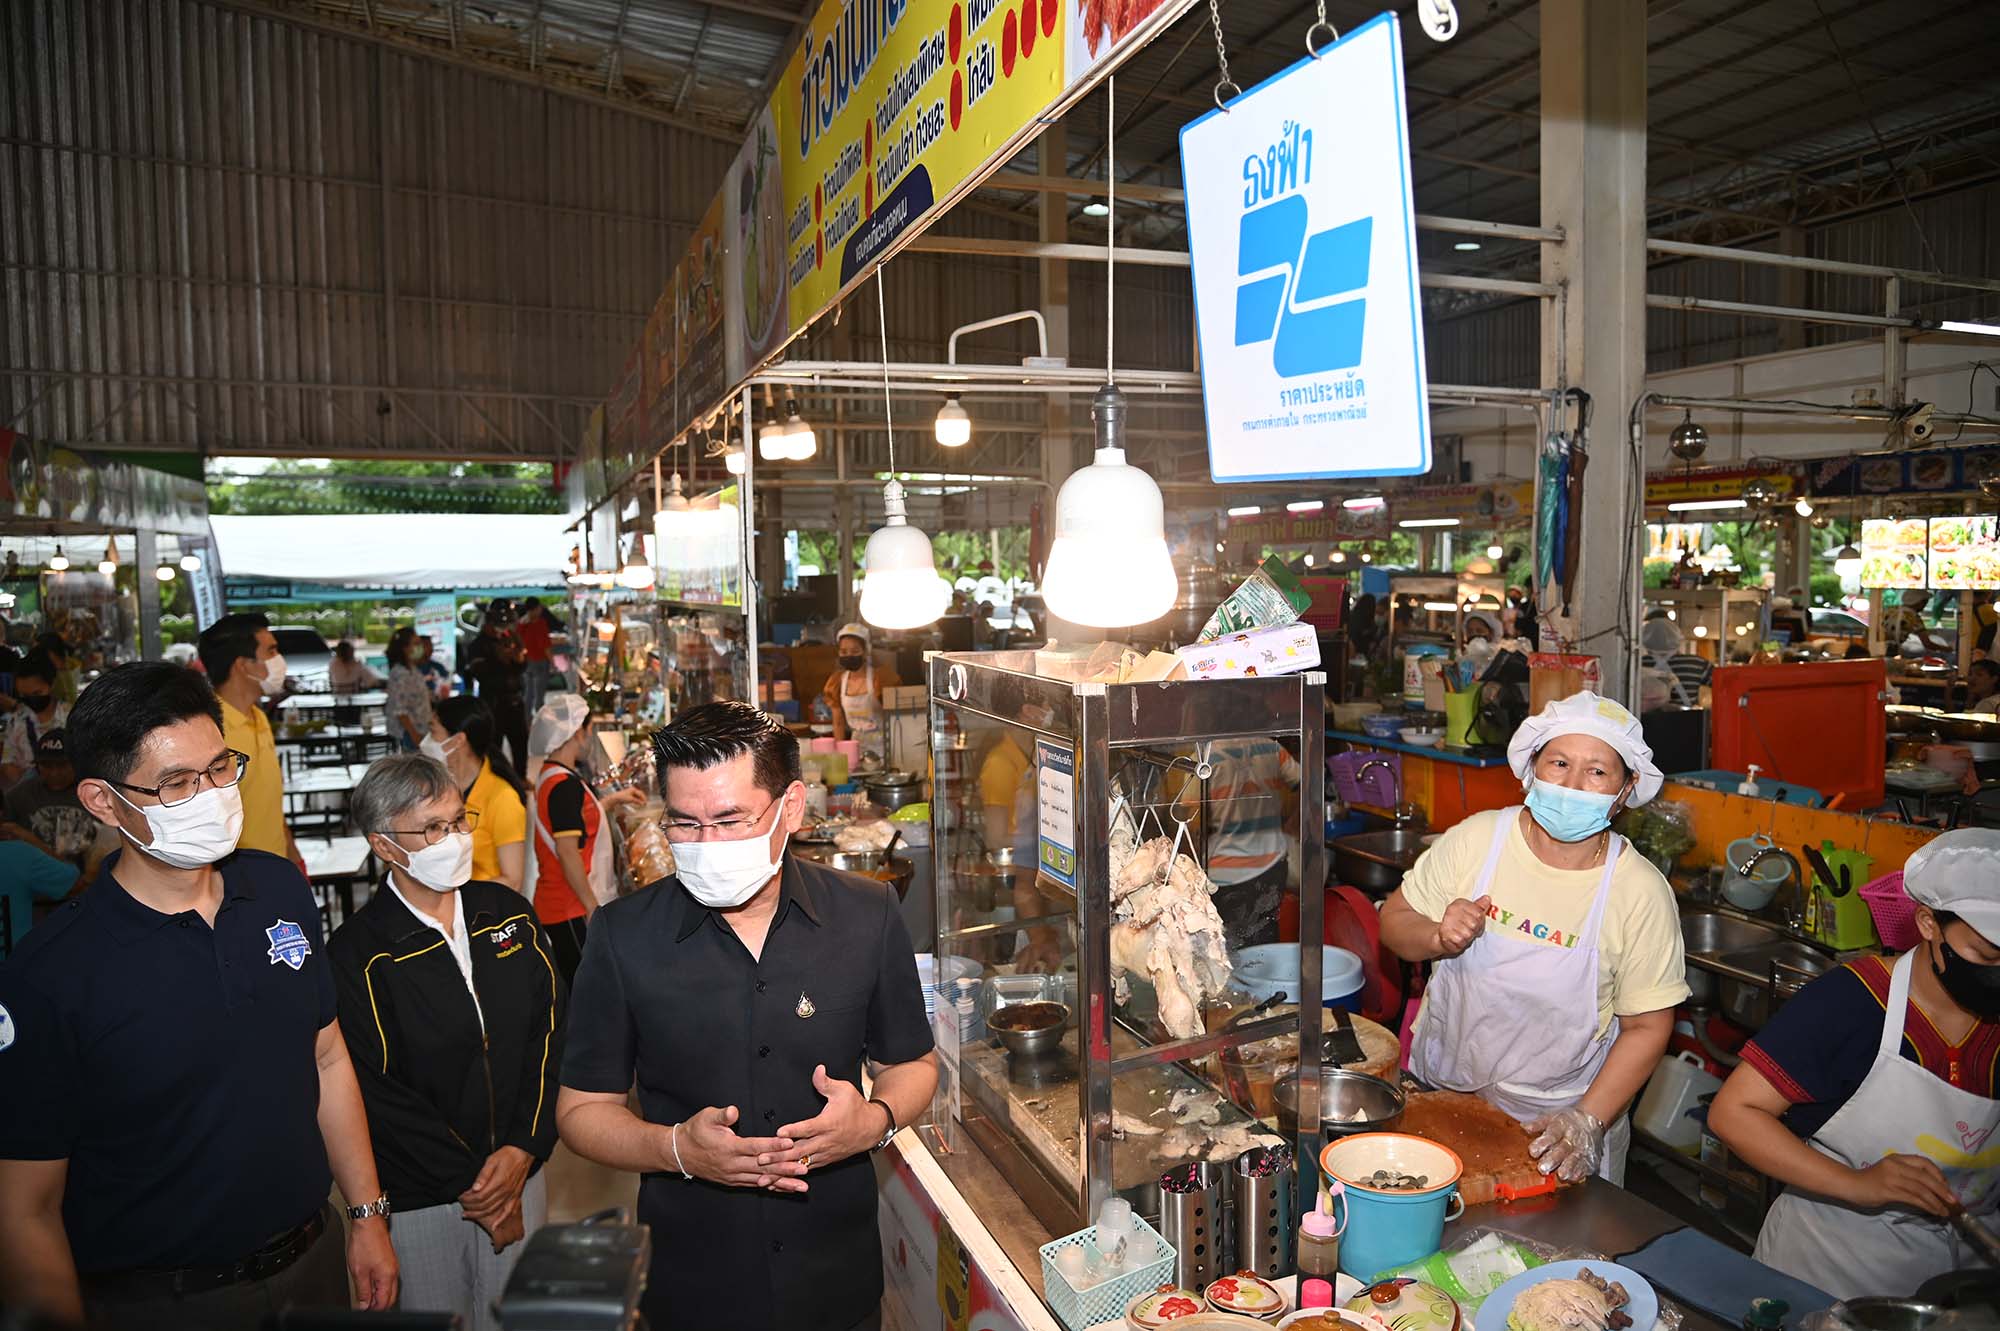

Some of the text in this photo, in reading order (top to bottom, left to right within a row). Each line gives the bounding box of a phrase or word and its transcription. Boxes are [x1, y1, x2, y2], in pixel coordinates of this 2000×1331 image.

[966, 43, 995, 105] ไก่สับ
[1243, 119, 1313, 209] ธงฟ้า
[1280, 371, 1366, 408] ราคาประหยัด
[1517, 918, 1580, 948] AGAI
